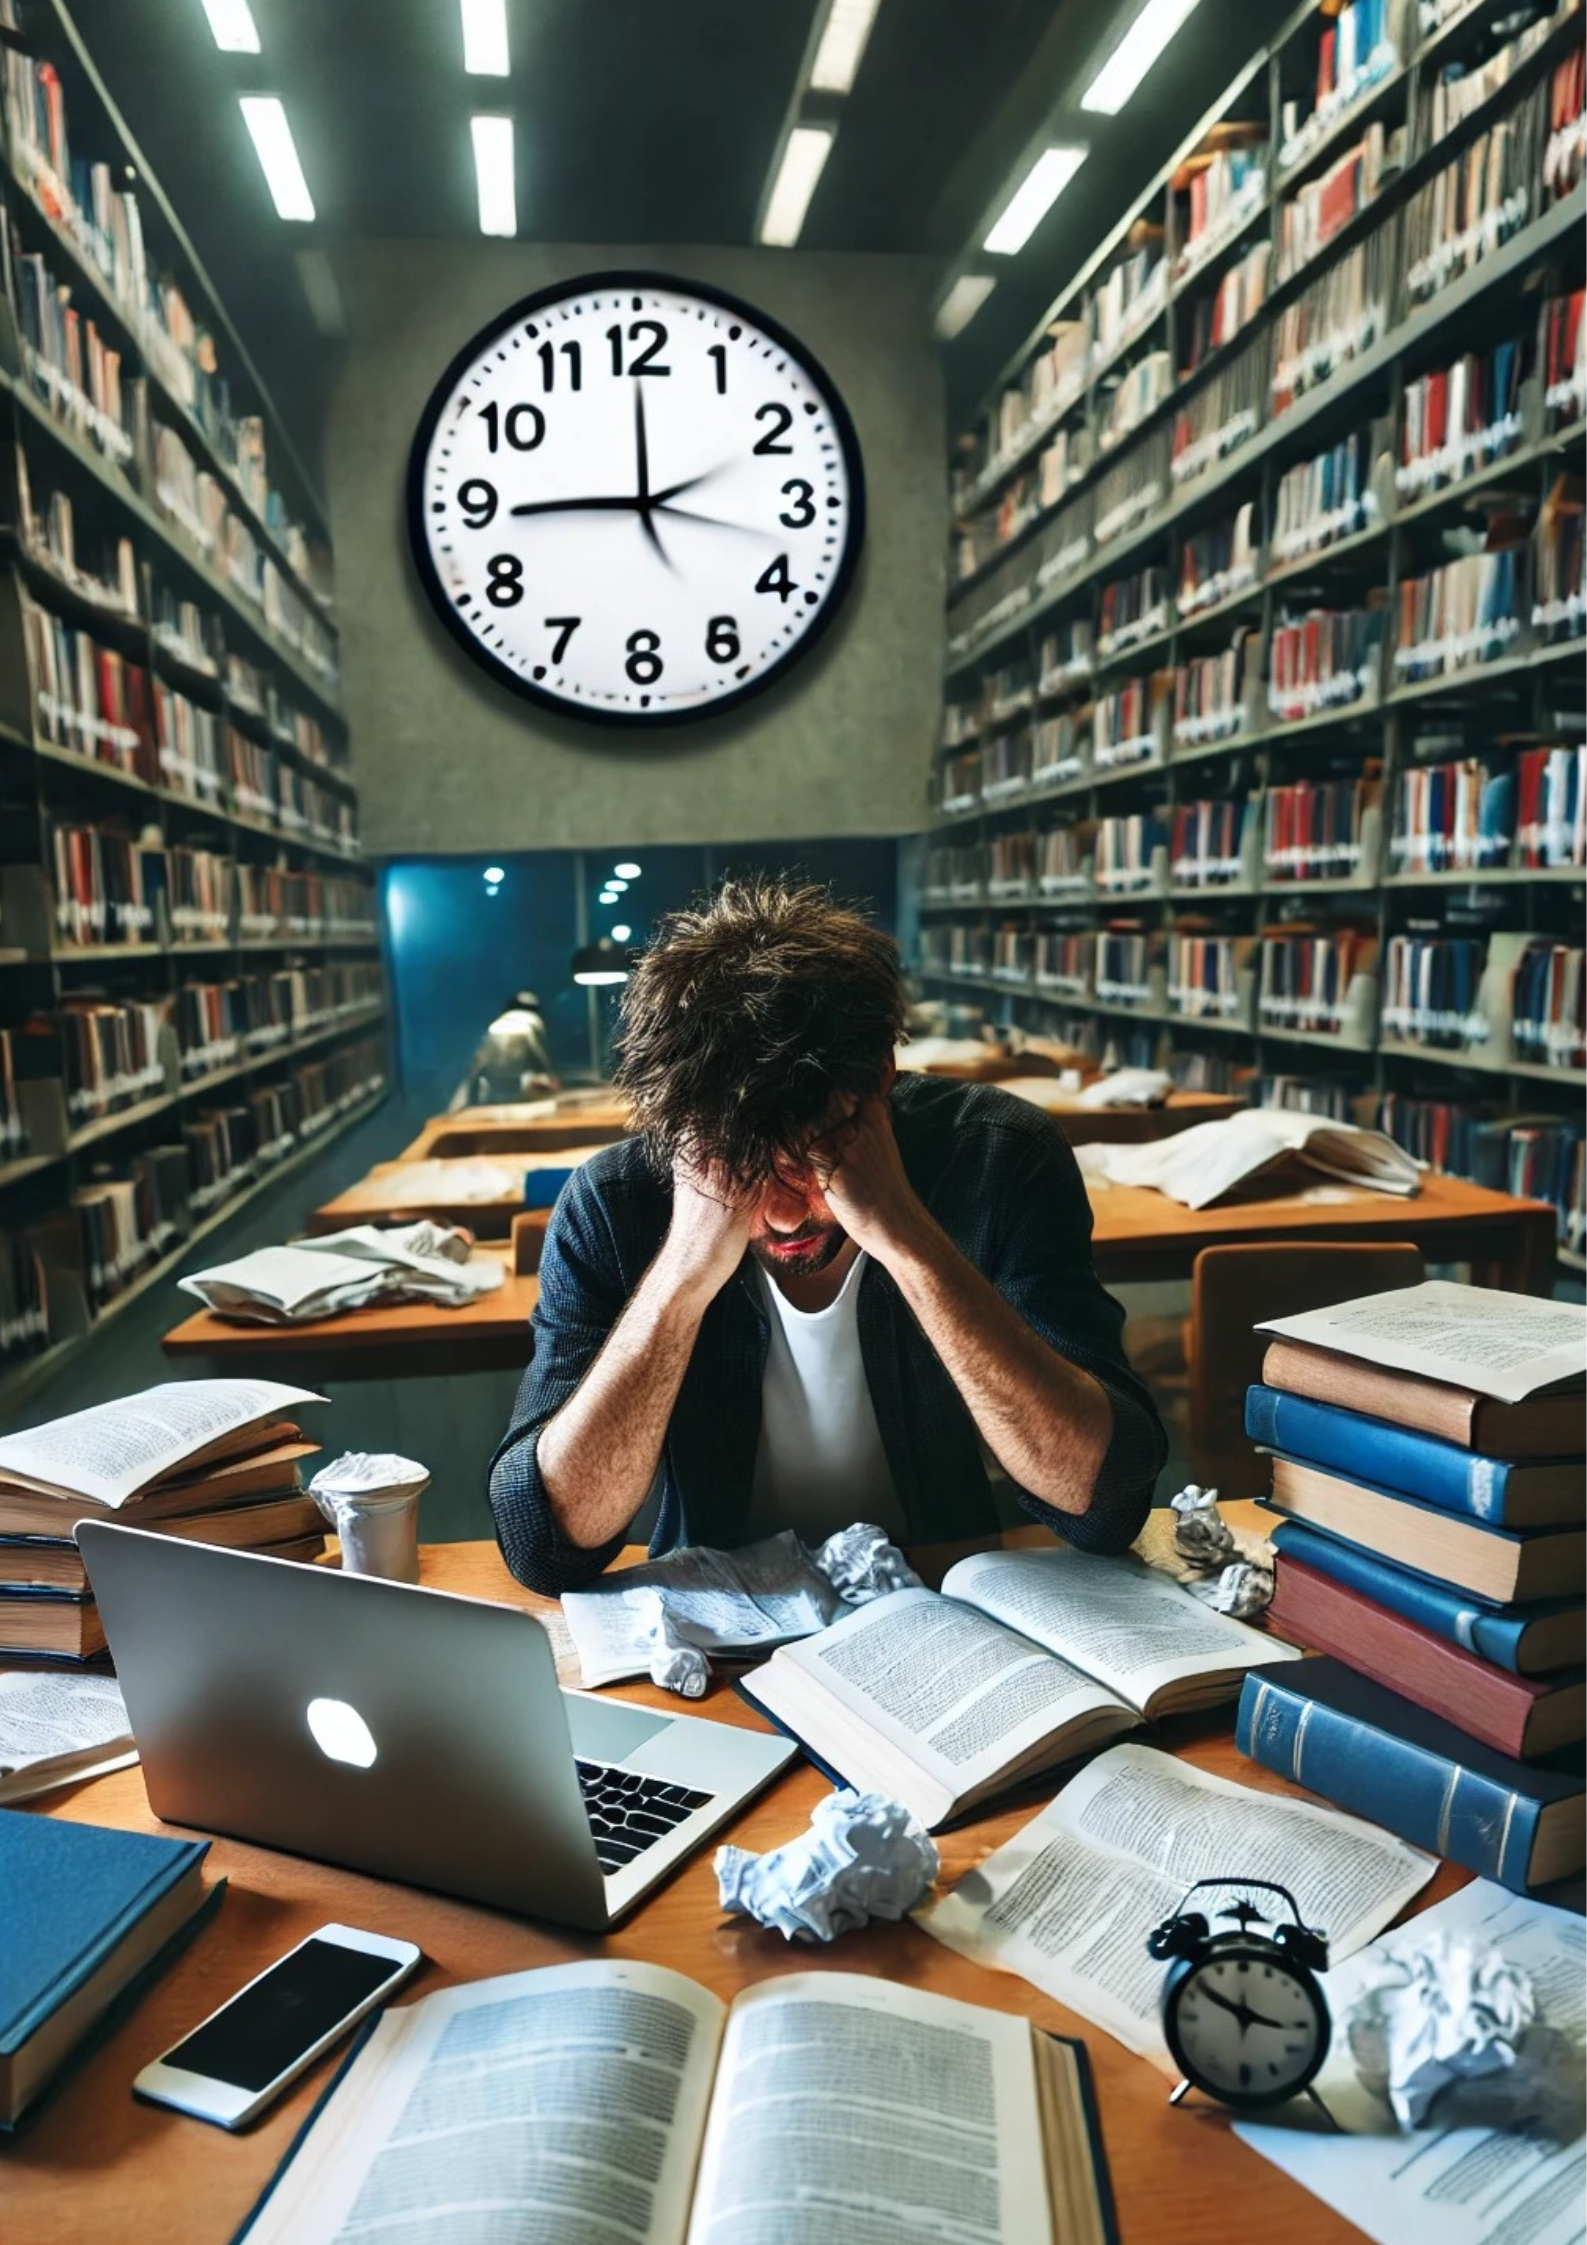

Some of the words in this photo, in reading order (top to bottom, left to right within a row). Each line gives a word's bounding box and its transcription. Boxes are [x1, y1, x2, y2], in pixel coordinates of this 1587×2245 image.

[537, 340, 582, 393] 11
[606, 320, 671, 377] 12
[707, 344, 726, 395] 1
[478, 401, 546, 454] 10
[752, 402, 793, 456] 2
[457, 478, 499, 530] 9
[779, 478, 816, 529] 3
[485, 553, 524, 608] 8
[754, 553, 799, 604] 4
[544, 616, 581, 665] 7
[625, 629, 664, 686] 8
